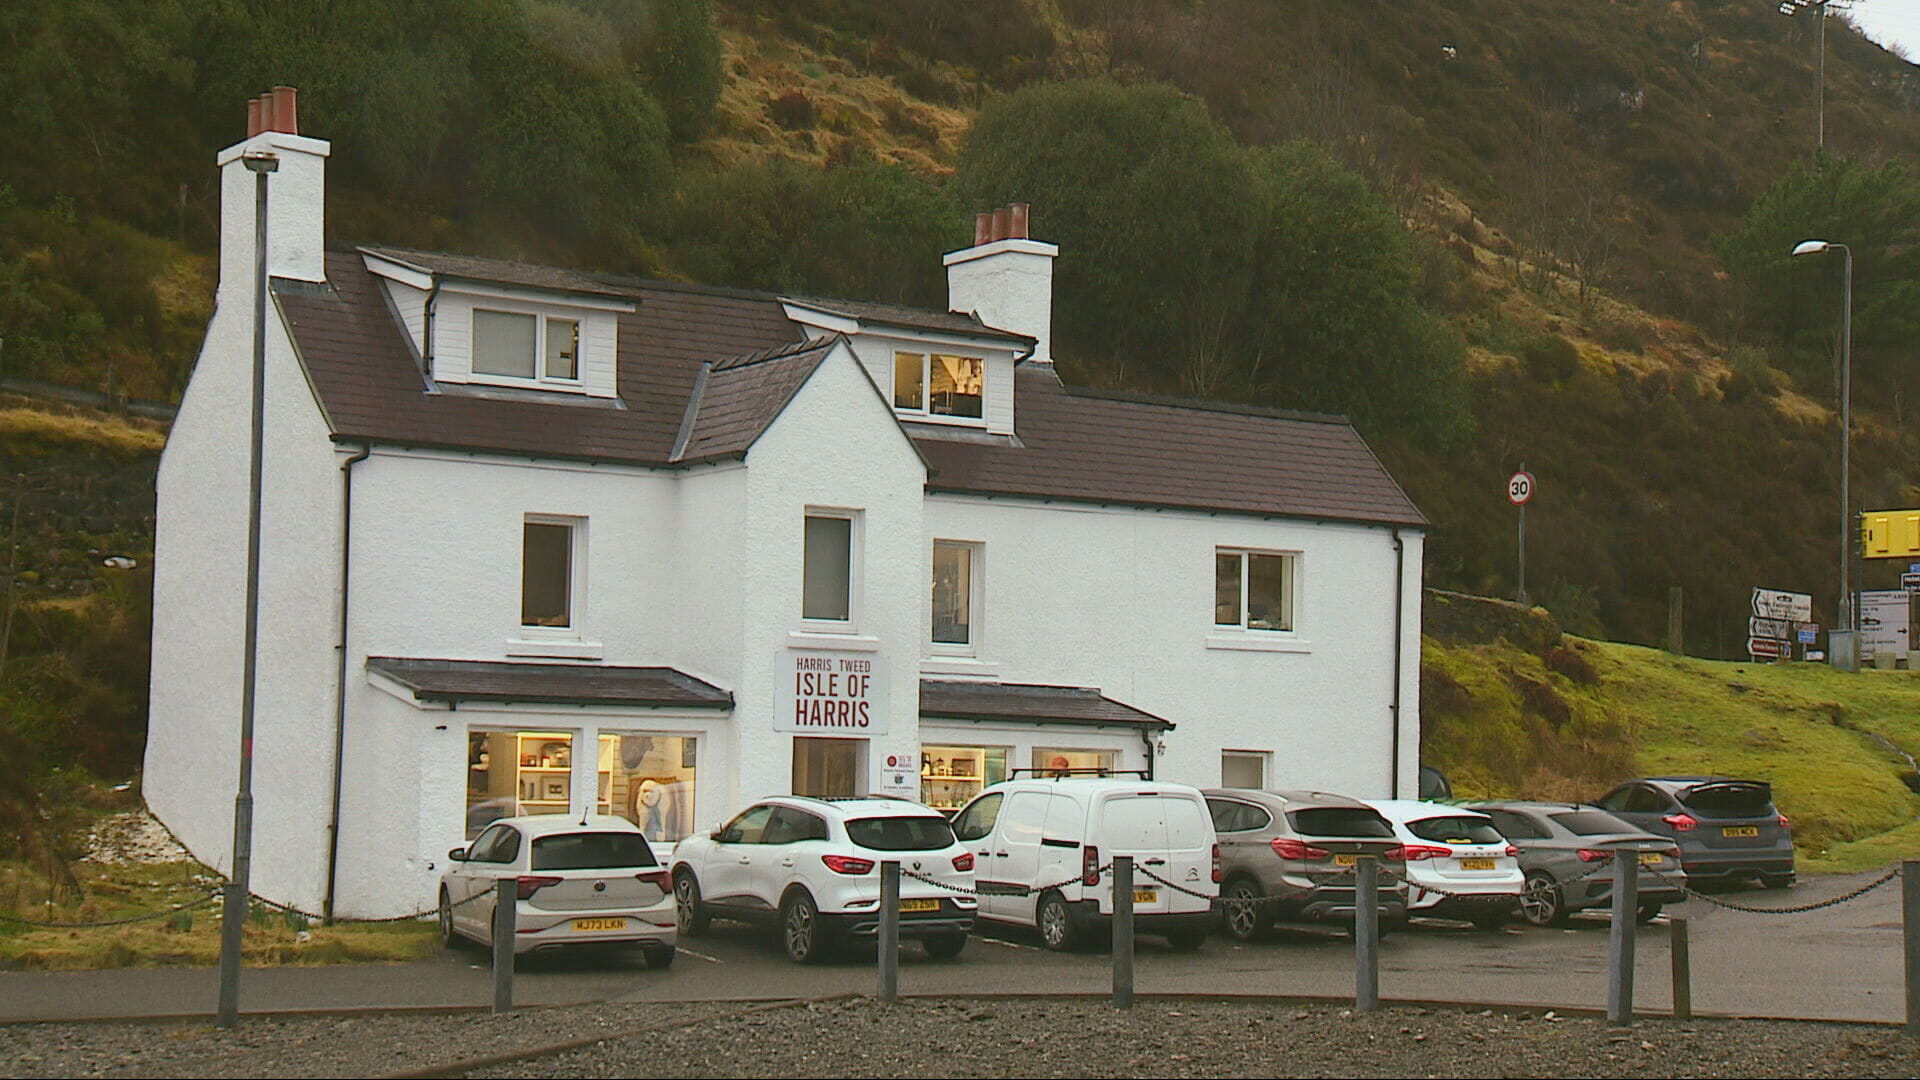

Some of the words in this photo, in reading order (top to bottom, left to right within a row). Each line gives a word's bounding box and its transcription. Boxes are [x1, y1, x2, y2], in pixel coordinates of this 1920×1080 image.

[1511, 481, 1528, 495] 30
[796, 657, 832, 672] HARRIS
[839, 659, 871, 673] TWEED
[796, 672, 839, 697] ISLE
[848, 674, 871, 698] OF
[795, 699, 870, 728] HARRIS
[605, 919, 623, 929] LKN
